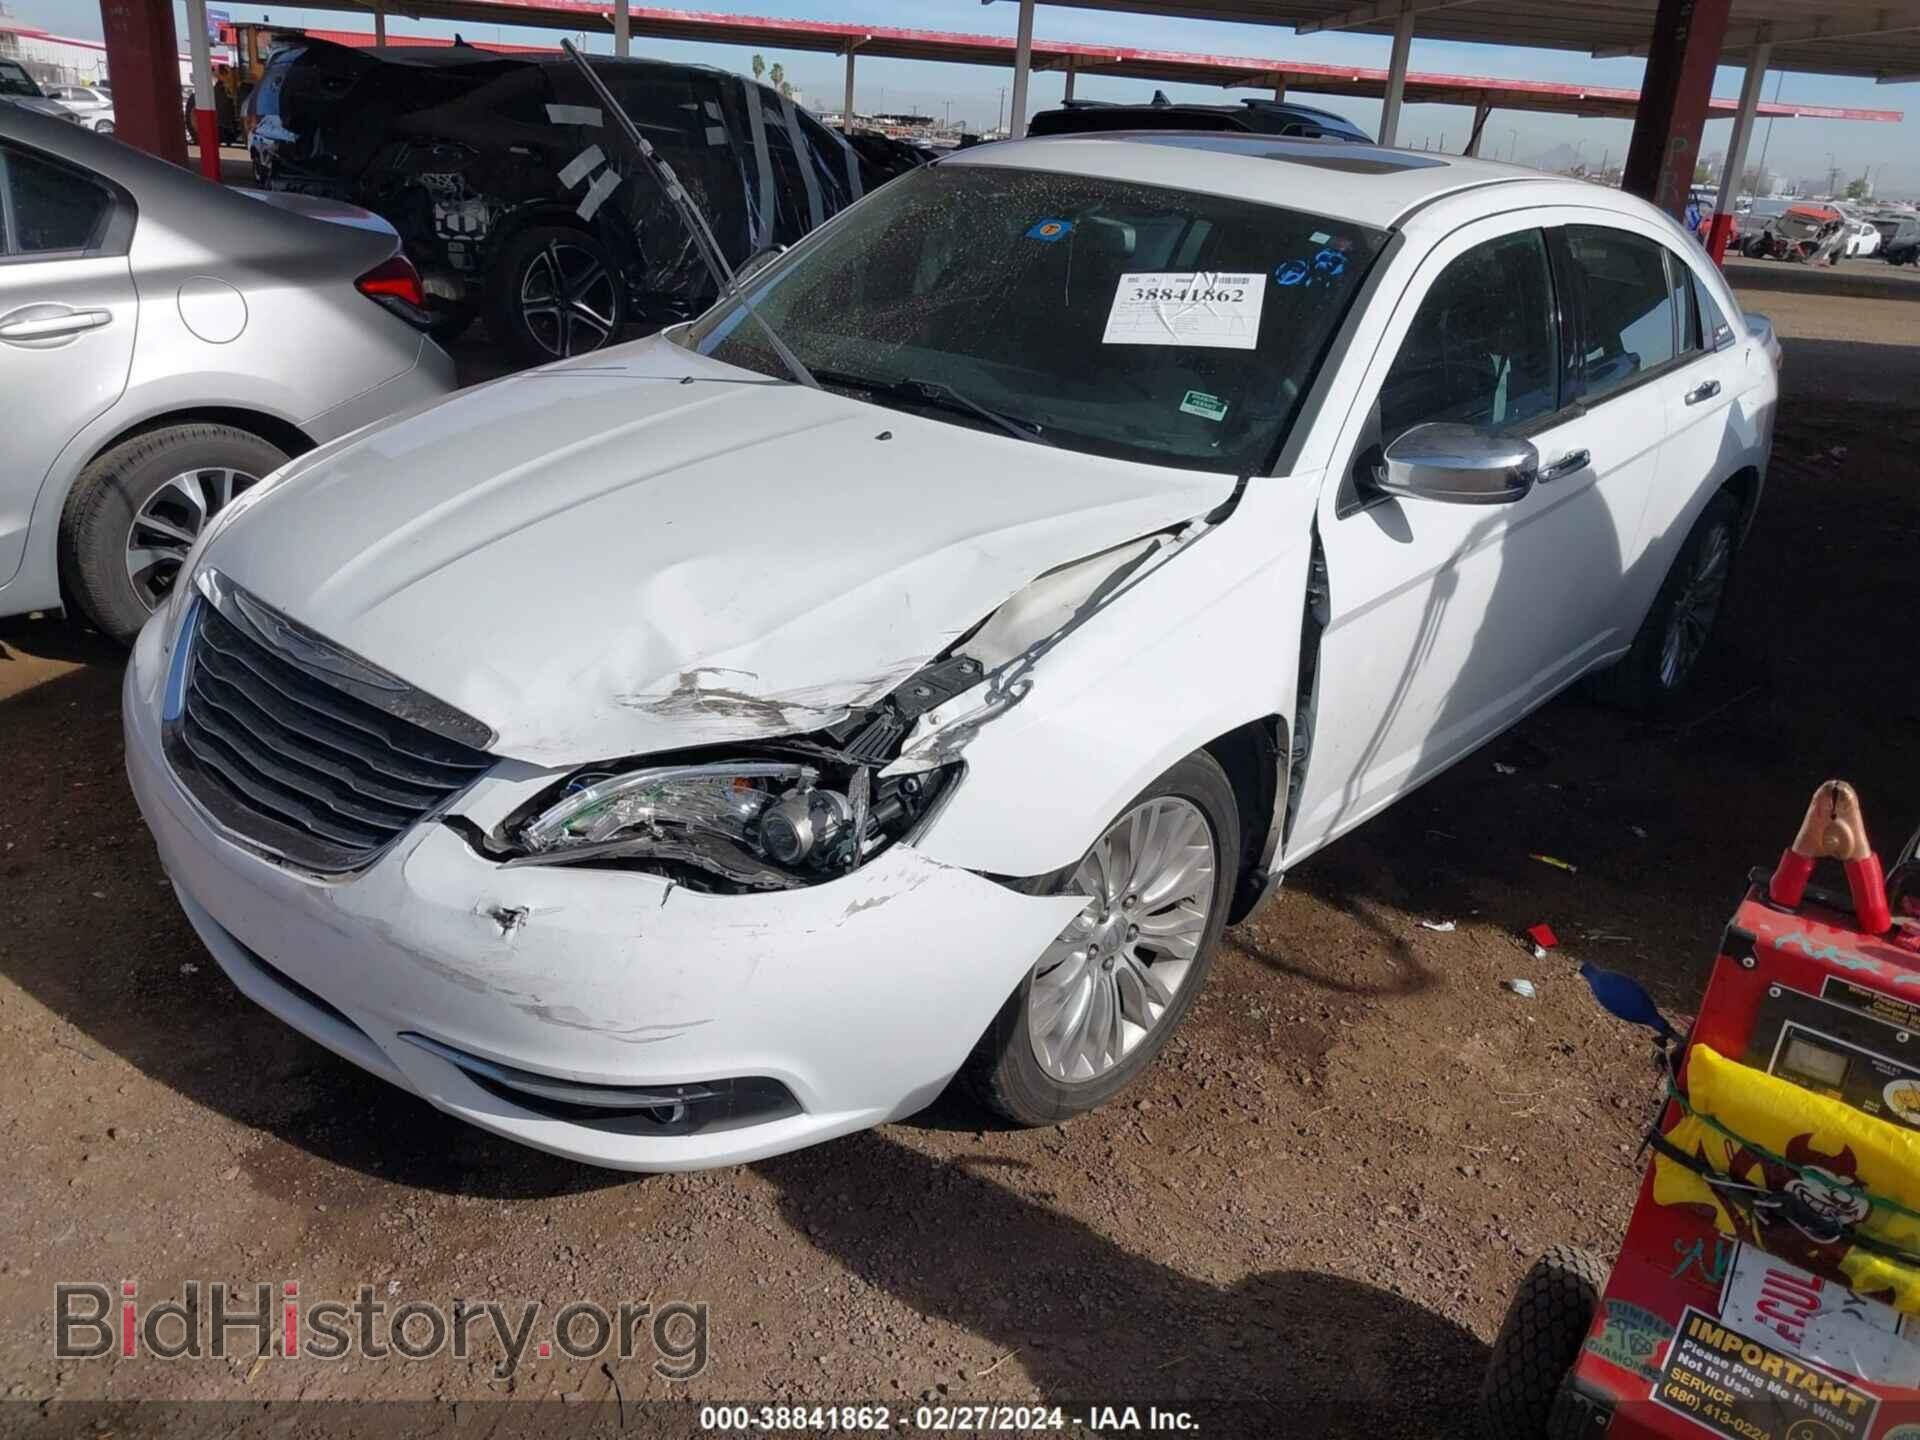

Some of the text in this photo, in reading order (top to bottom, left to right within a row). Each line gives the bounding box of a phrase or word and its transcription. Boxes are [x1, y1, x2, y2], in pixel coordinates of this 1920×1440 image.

[1130, 287, 1245, 303] 38841862
[1670, 1367, 1735, 1408] SERVICE
[1677, 1352, 1755, 1398] Not In Use.
[1683, 1340, 1856, 1433] Please Plug Me In When
[1688, 1317, 1866, 1416] IMPORTANT
[1664, 1383, 1701, 1411] (480)
